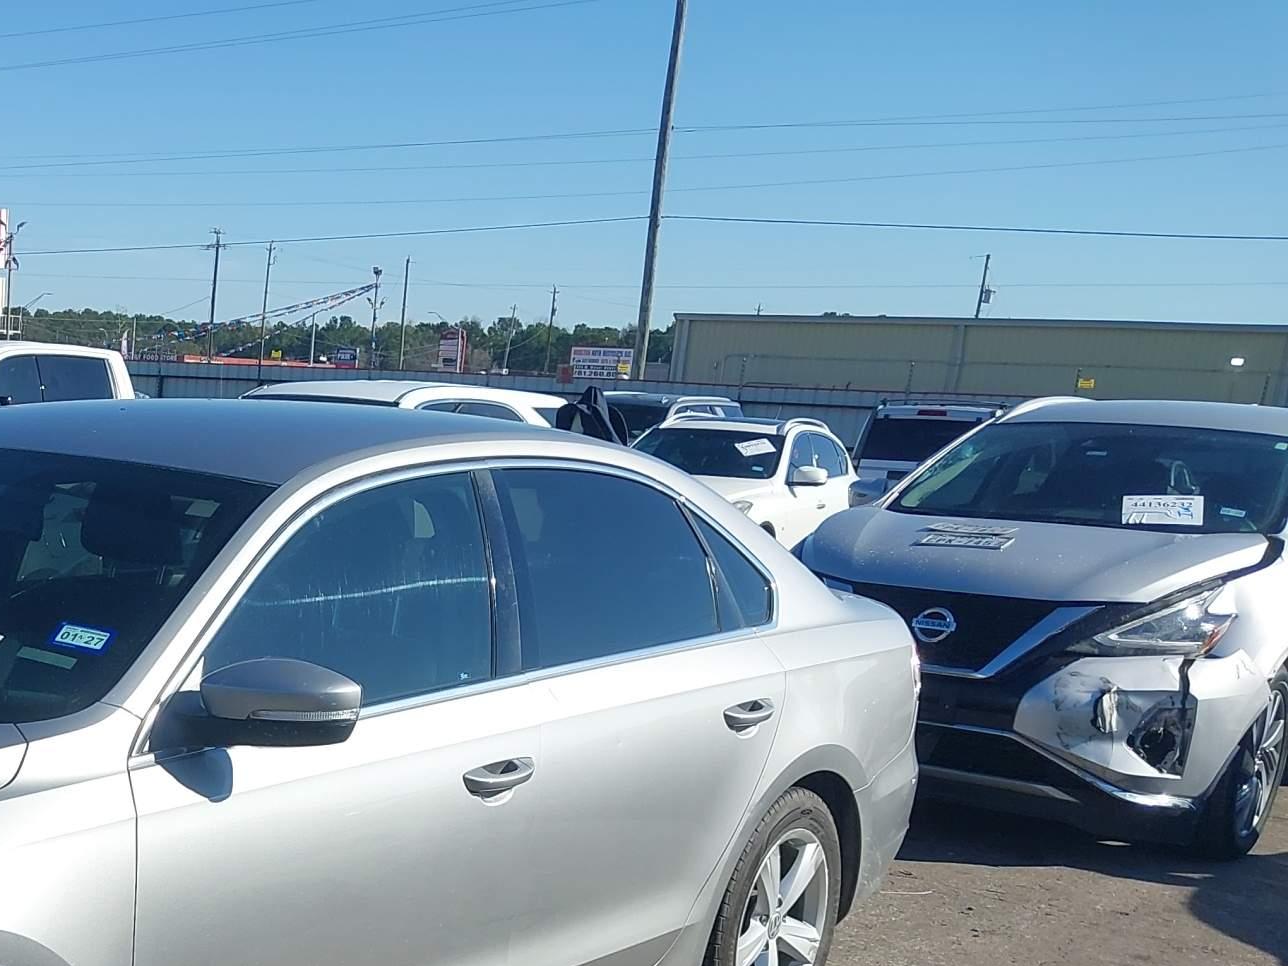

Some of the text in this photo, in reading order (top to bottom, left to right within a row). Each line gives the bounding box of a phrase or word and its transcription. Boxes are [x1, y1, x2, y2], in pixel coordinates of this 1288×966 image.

[915, 619, 951, 629] NISSAN
[60, 631, 104, 647] 01 27
